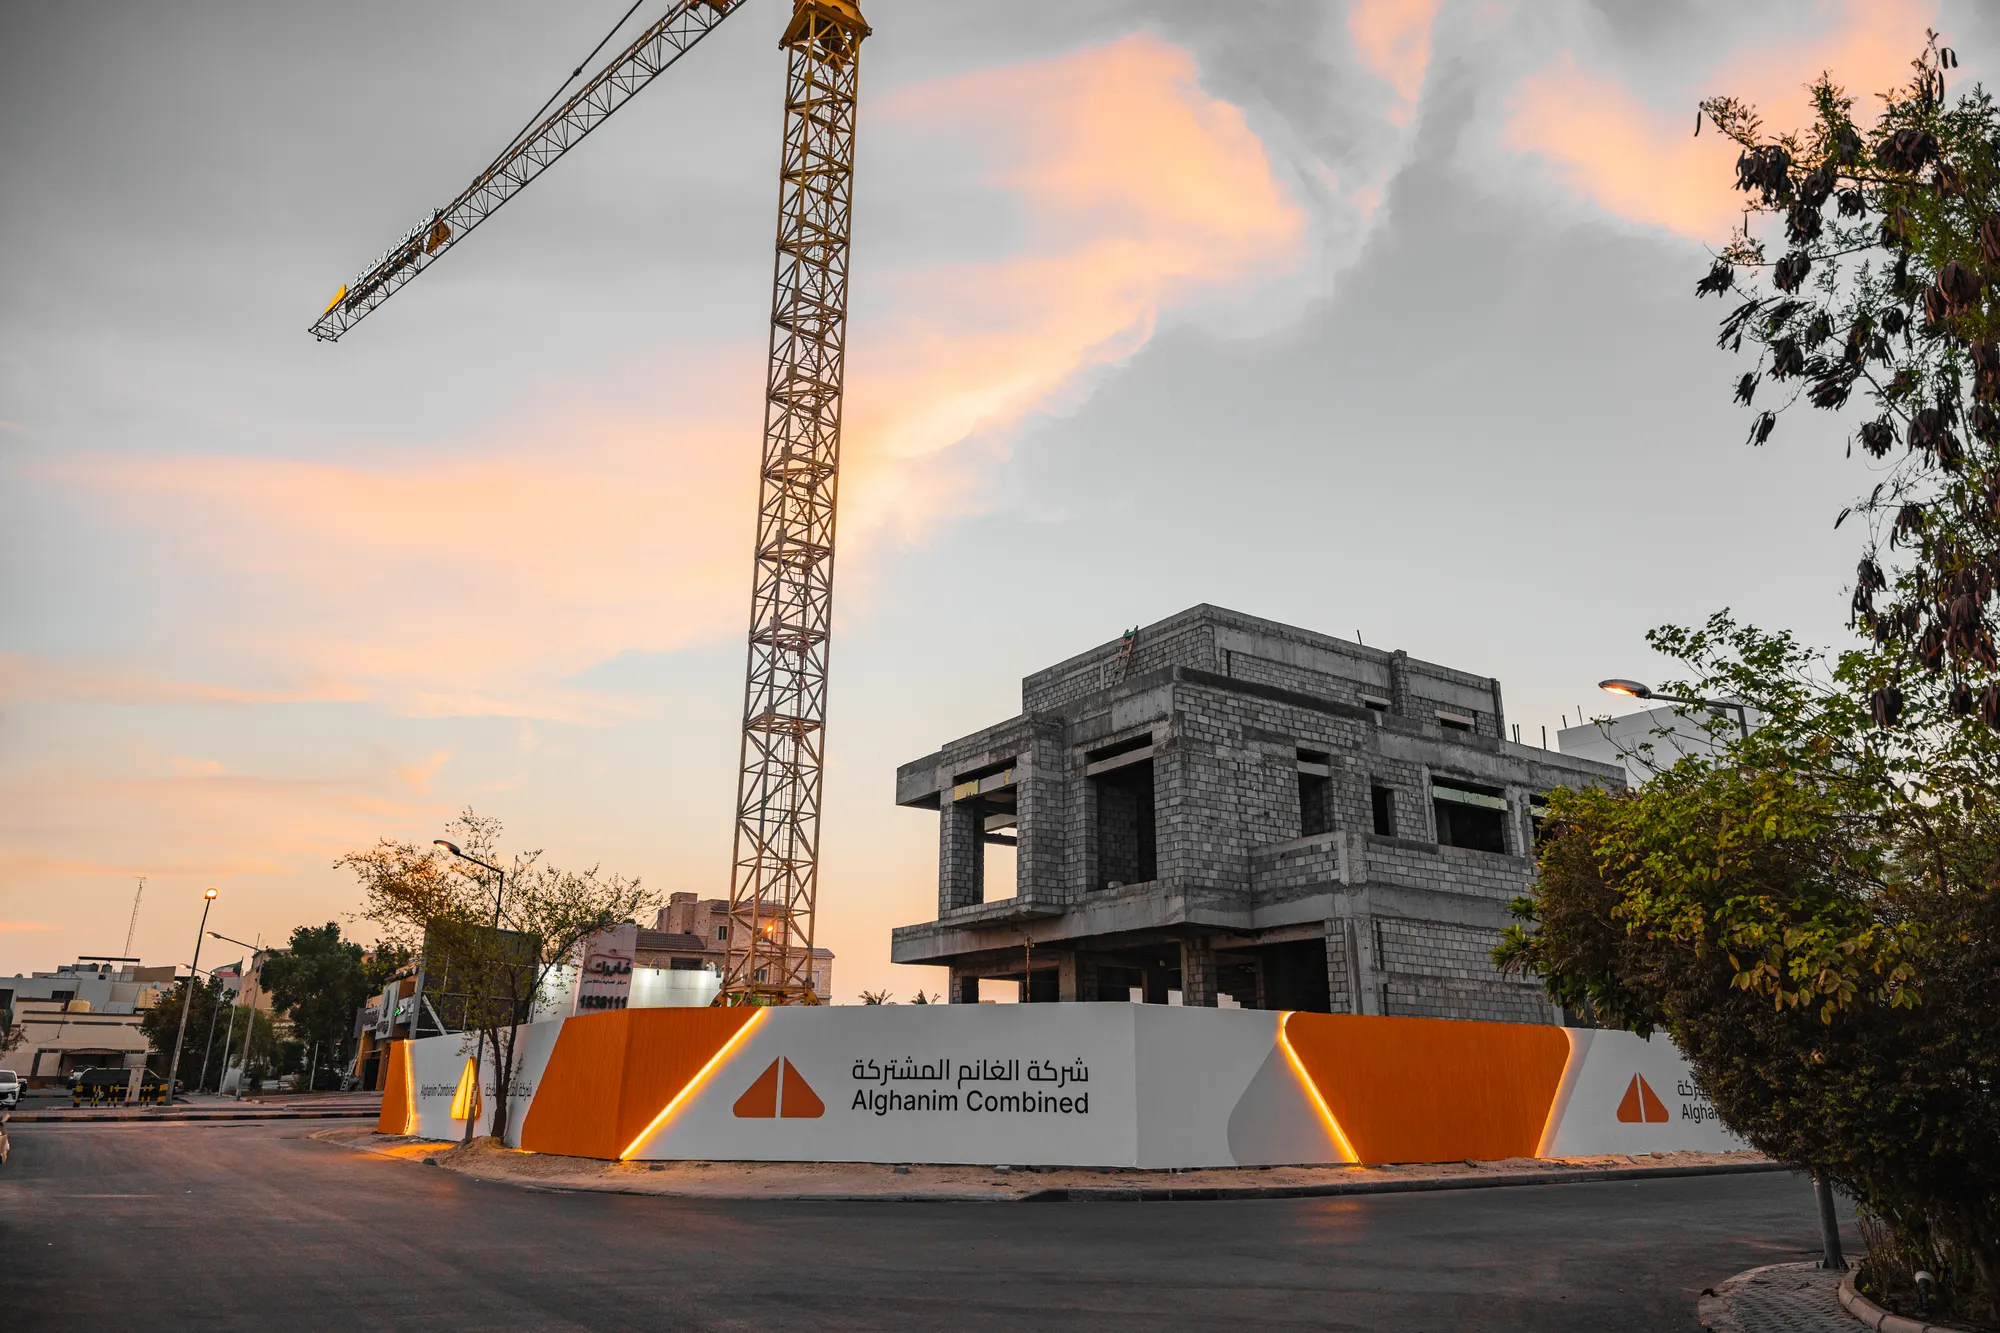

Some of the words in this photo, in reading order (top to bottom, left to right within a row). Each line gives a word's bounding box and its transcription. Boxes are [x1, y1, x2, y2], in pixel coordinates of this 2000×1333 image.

[852, 1056, 950, 1086] المشتركة
[957, 1059, 1019, 1089] الغانم
[1027, 1057, 1089, 1088] شركة
[851, 1089, 958, 1116] Alghanim
[966, 1090, 1089, 1114] Combined
